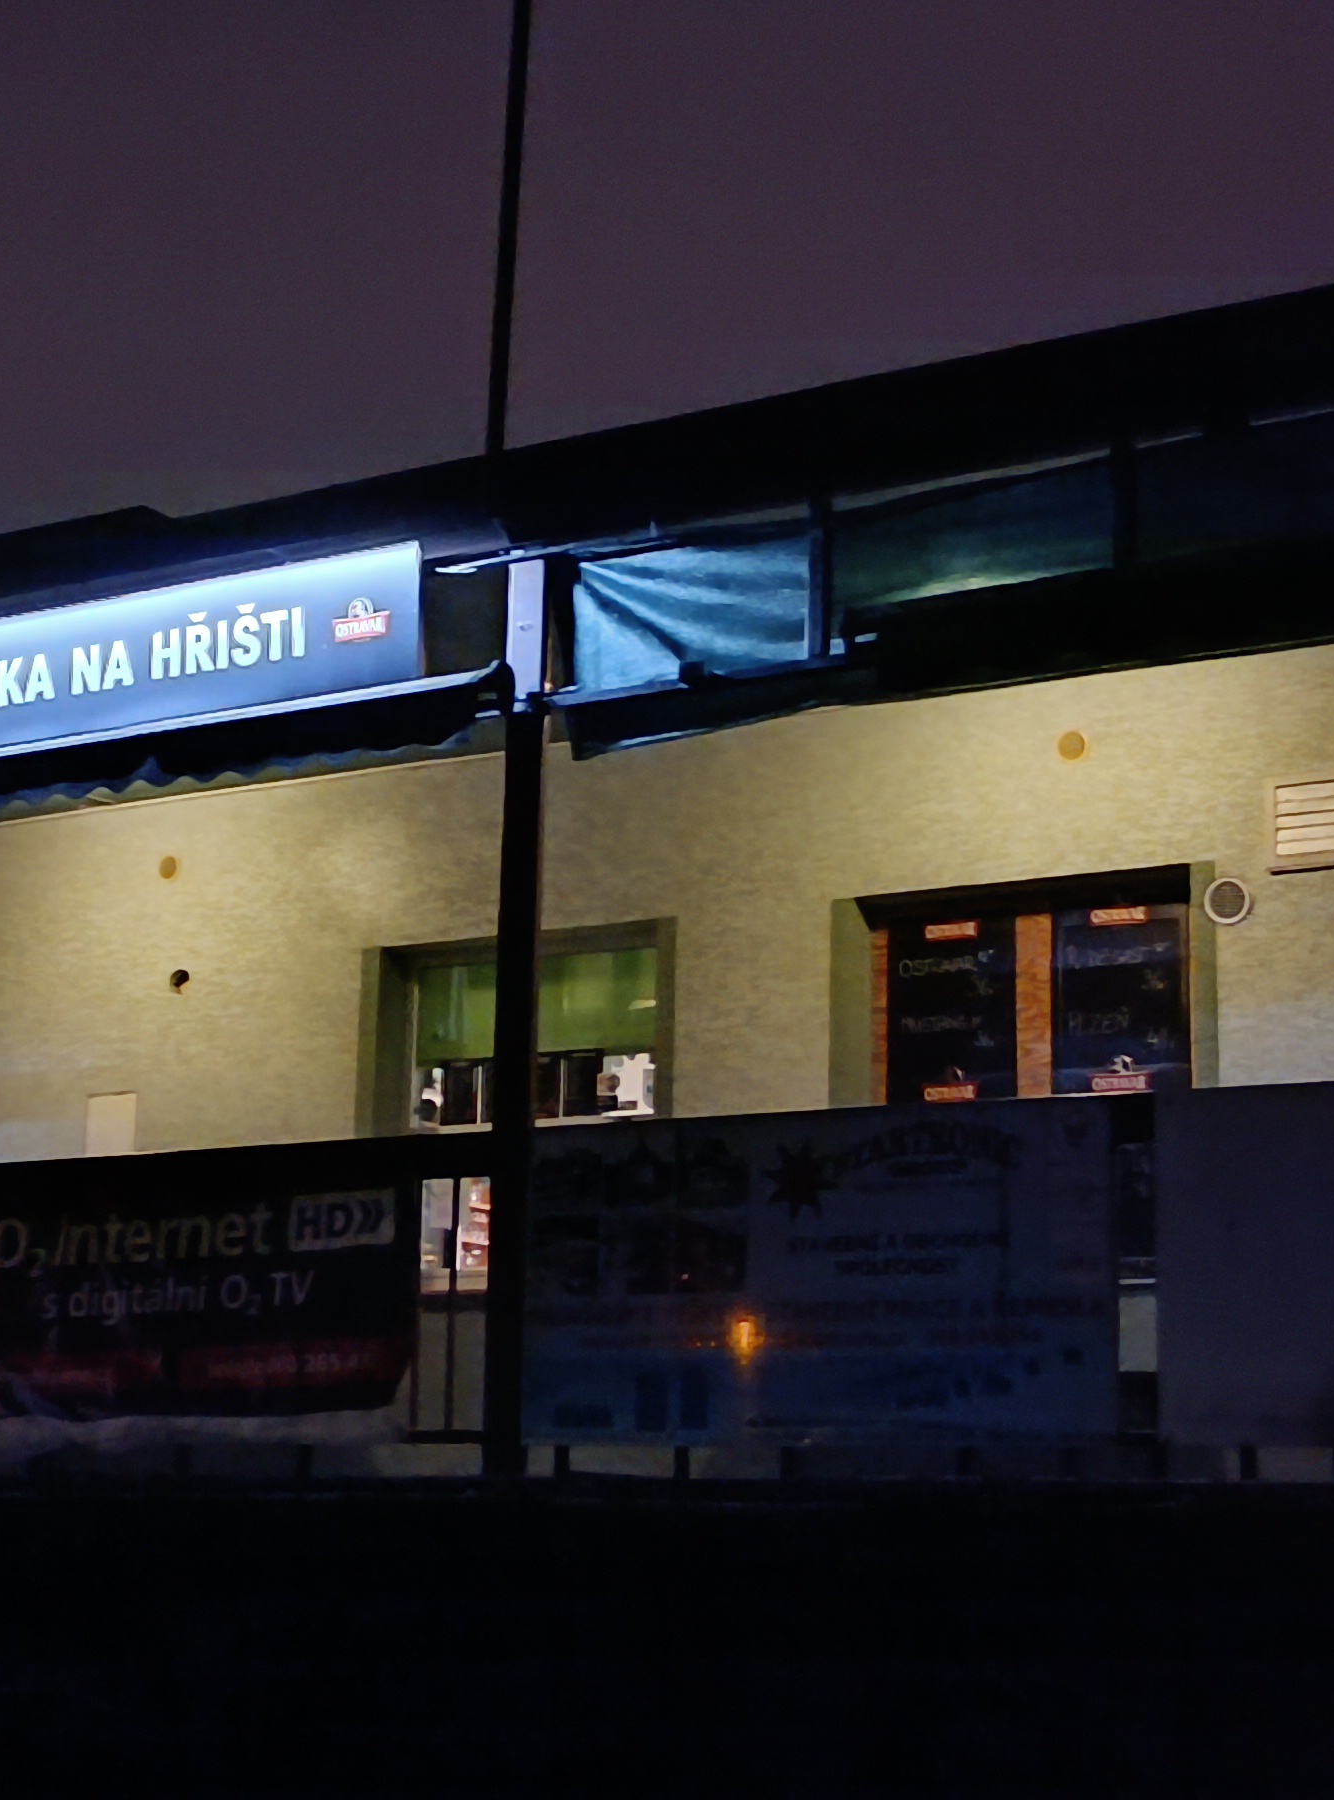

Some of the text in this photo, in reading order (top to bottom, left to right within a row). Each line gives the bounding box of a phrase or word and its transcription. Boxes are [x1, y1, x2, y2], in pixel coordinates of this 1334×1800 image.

[70, 639, 134, 697] NA
[149, 602, 306, 681] HŘIŠTI
[68, 1274, 209, 1327] digitální
[269, 1269, 316, 1306] TV
